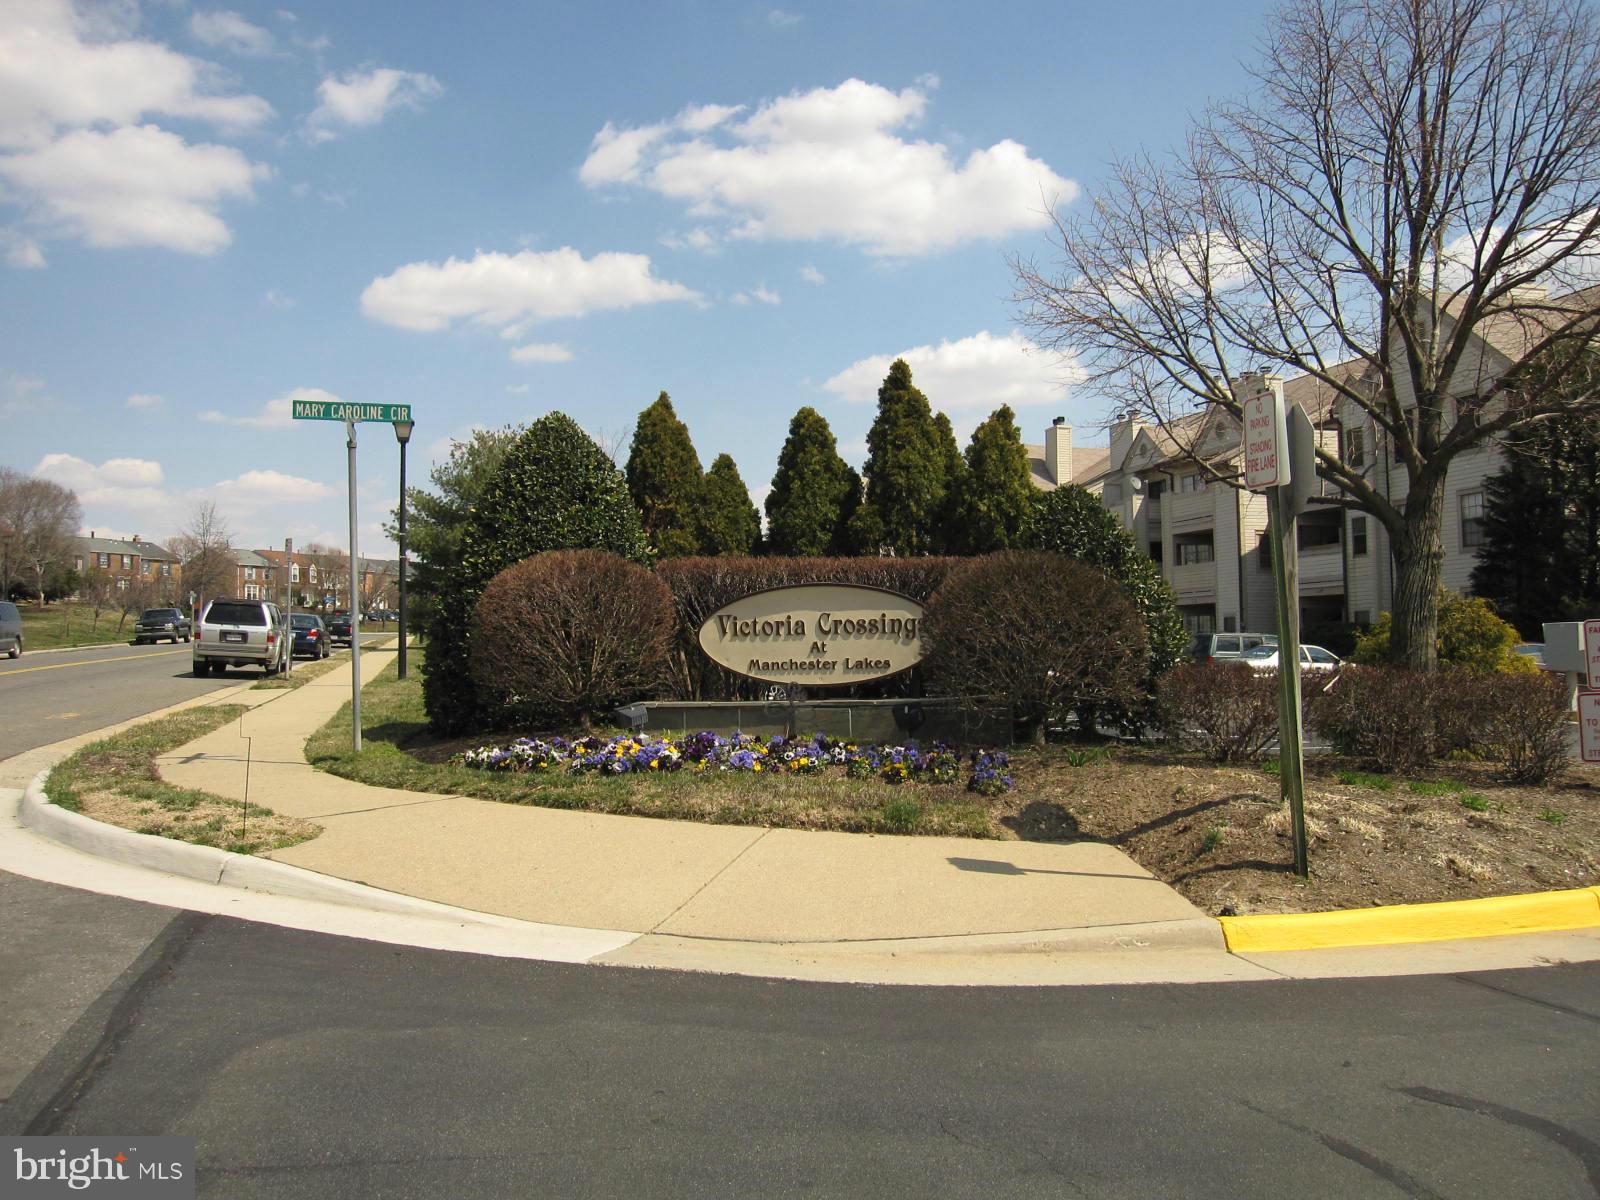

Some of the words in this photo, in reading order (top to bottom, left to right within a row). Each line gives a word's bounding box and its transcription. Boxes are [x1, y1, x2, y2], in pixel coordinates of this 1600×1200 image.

[295, 402, 326, 417] MARY
[331, 404, 384, 420] CAROLINE
[390, 406, 409, 421] CIR
[1255, 402, 1264, 415] NO
[1250, 415, 1270, 431] PARKING
[1250, 439, 1272, 455] STANDING
[1247, 458, 1260, 473] FIRE
[1260, 454, 1276, 471] LANE
[716, 614, 806, 638] Victoria
[809, 641, 827, 653] At
[749, 658, 838, 671] Manchester
[844, 657, 891, 670] Lakes
